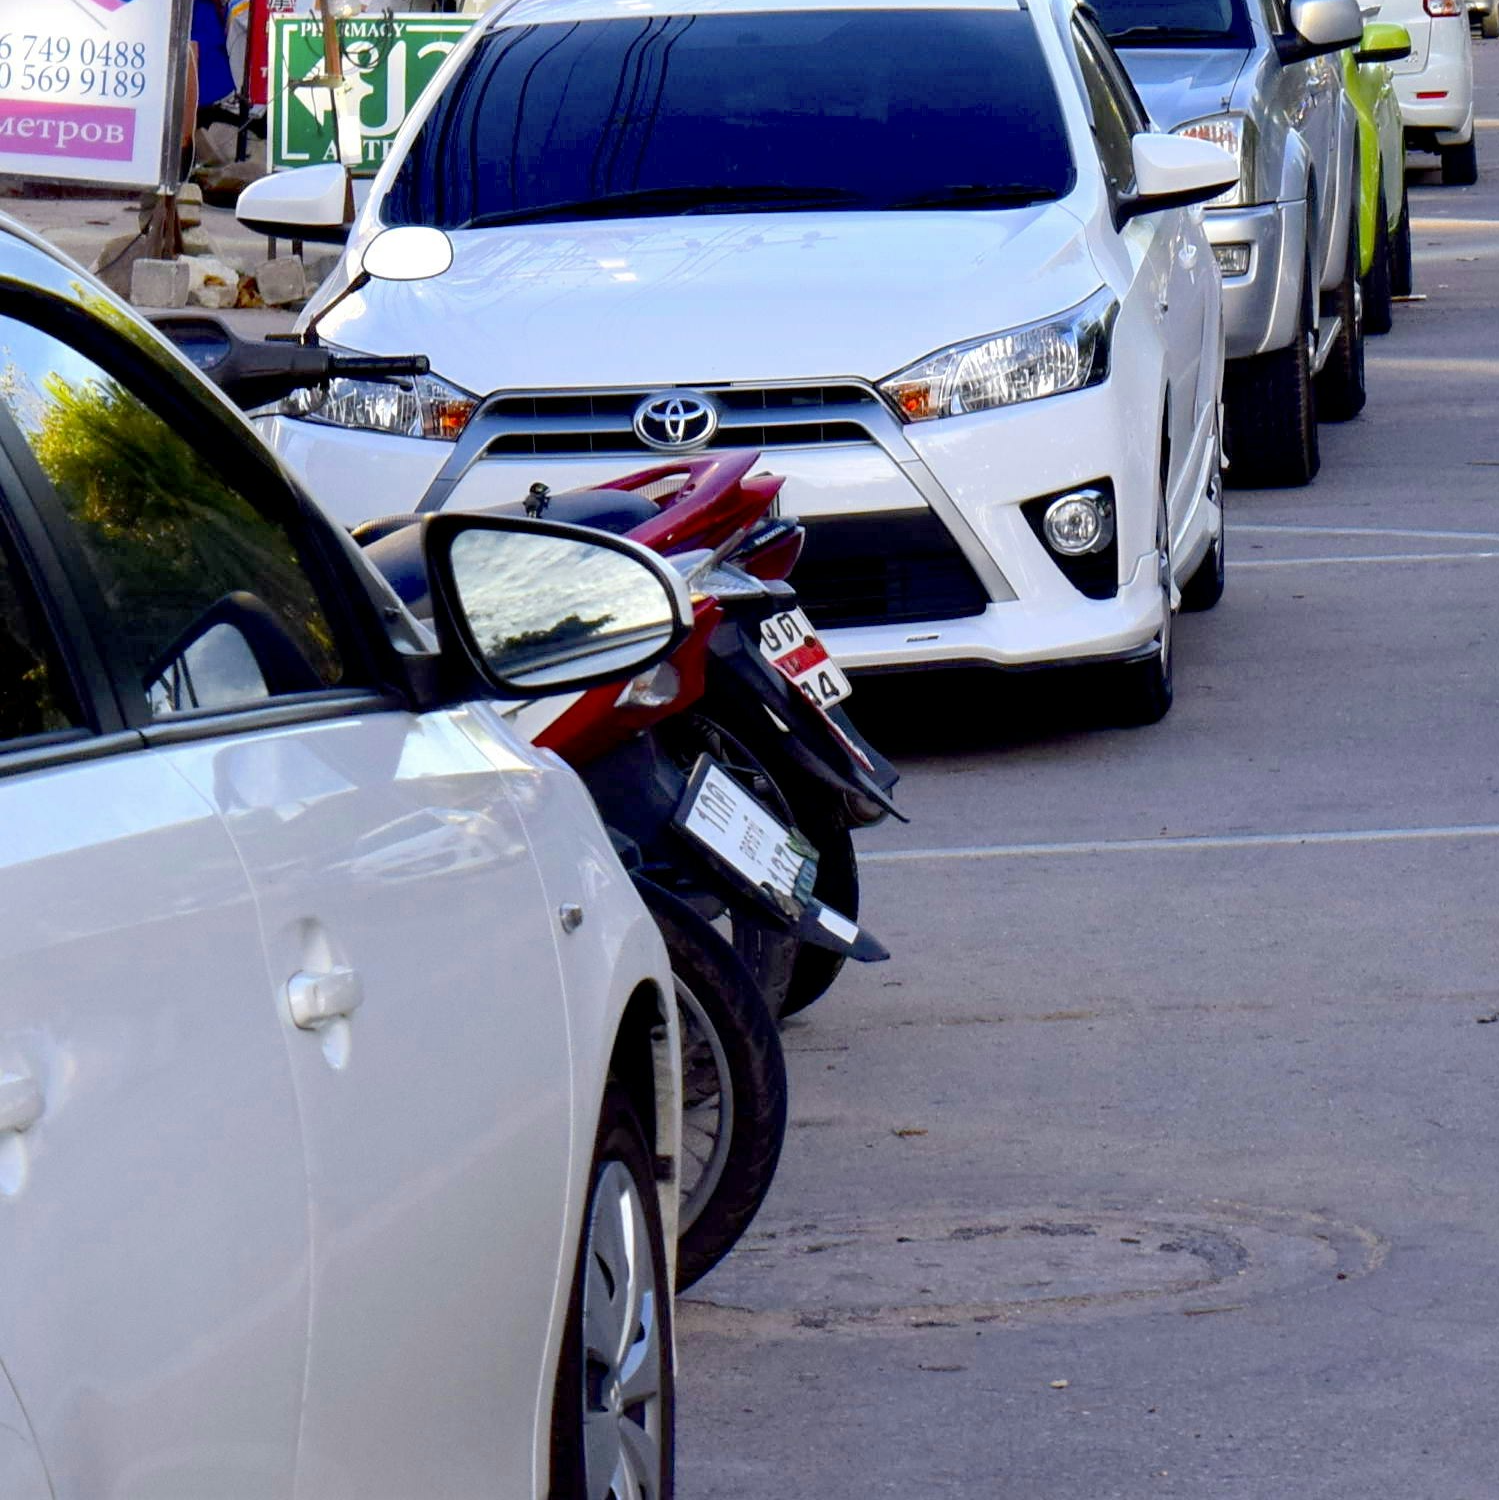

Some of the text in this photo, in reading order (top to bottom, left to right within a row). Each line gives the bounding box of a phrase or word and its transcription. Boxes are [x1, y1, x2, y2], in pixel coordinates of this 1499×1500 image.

[300, 22, 406, 37] PHRMACY
[22, 35, 71, 63] 749
[80, 38, 146, 69] 0488
[21, 64, 71, 93] 569
[80, 68, 146, 98] 9189
